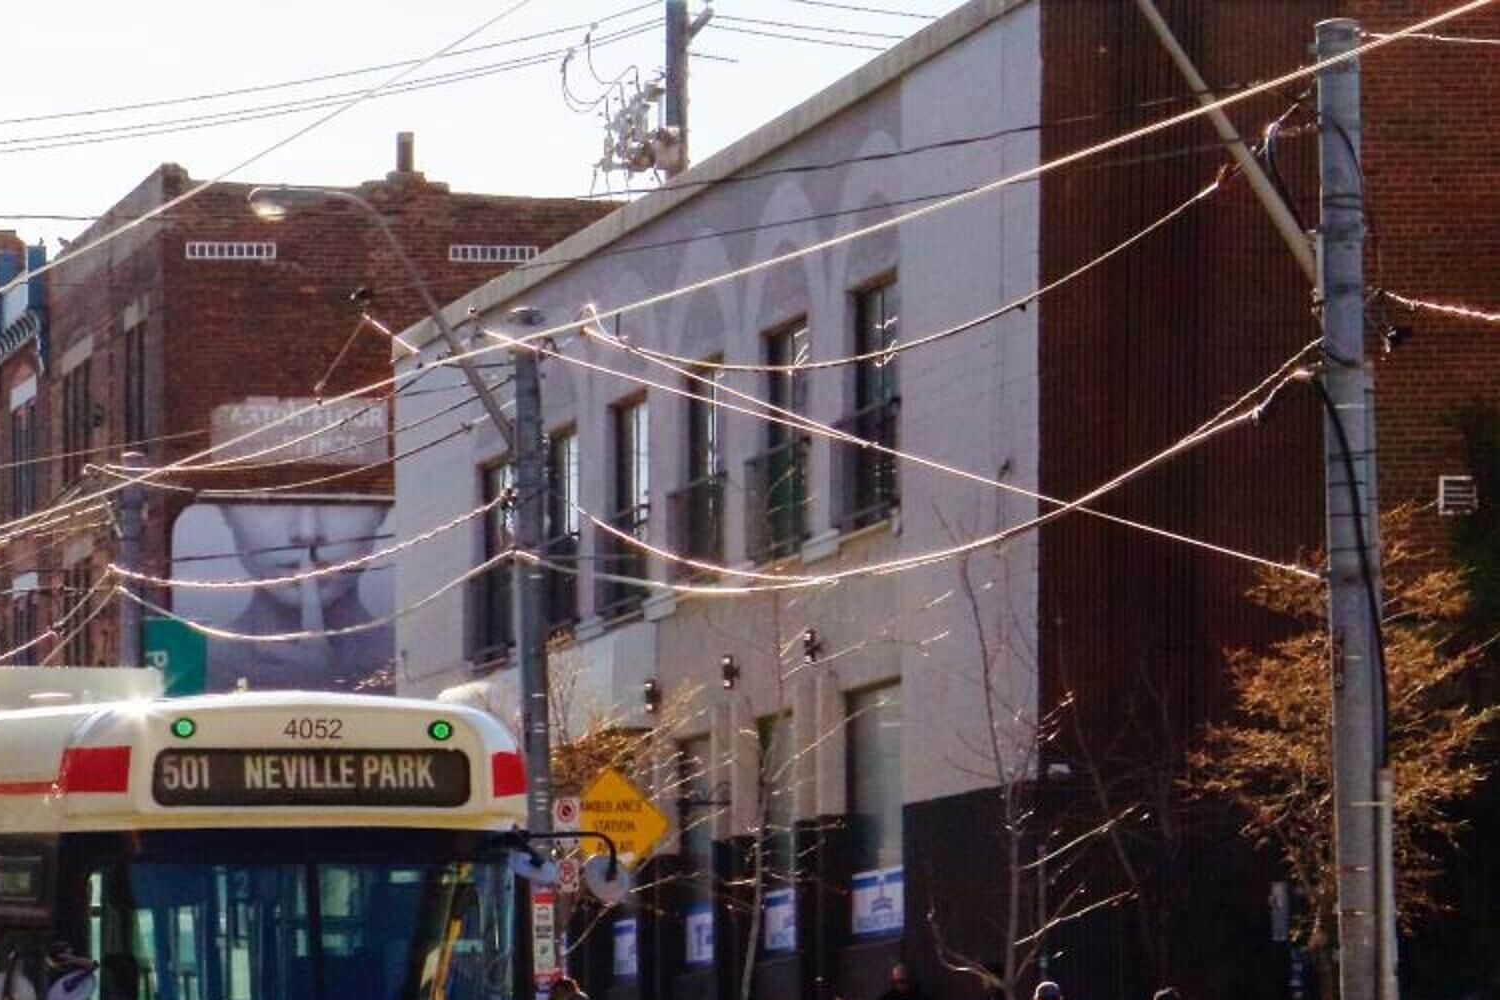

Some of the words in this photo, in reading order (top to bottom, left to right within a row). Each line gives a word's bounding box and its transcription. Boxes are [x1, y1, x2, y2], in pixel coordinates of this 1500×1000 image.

[284, 719, 342, 738] 4052
[163, 755, 209, 789] 501
[244, 755, 355, 790] NEVILLE
[363, 755, 435, 789] PARK
